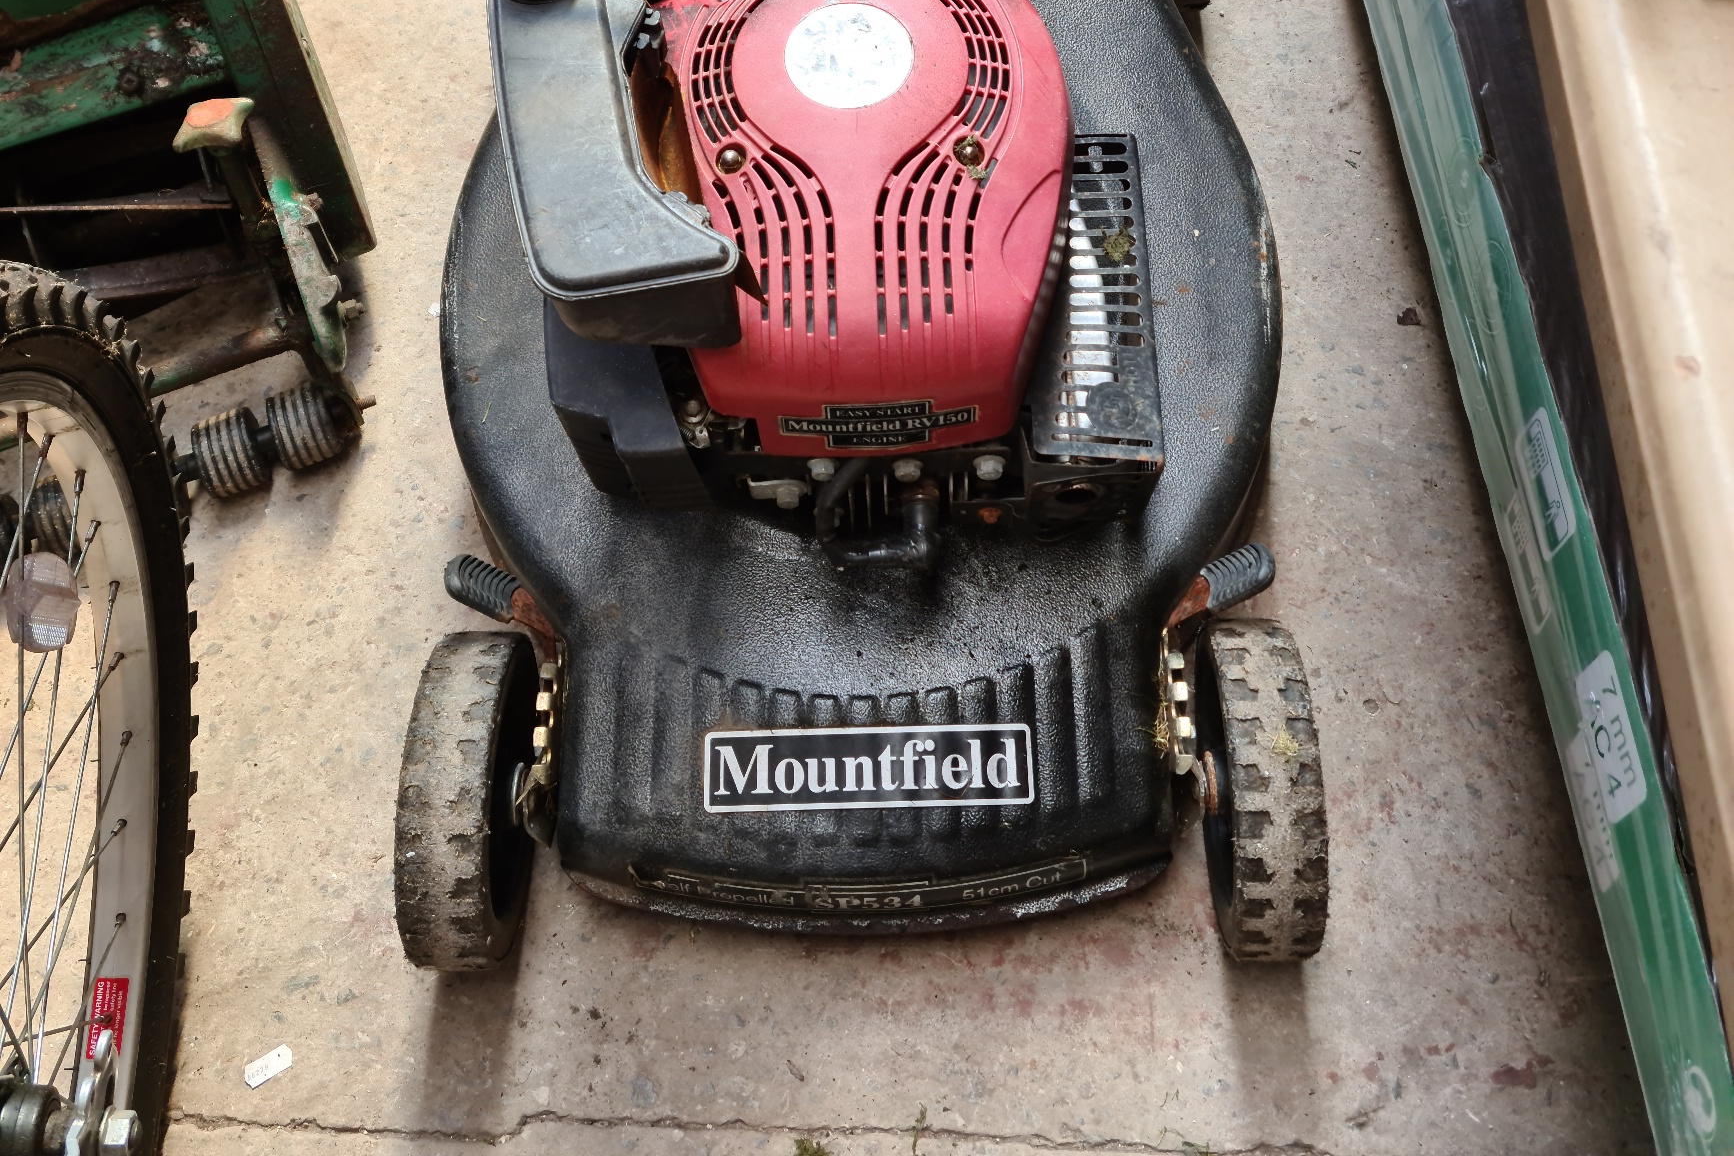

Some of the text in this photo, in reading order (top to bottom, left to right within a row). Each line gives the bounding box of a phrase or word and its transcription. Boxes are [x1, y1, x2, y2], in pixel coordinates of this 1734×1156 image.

[788, 411, 968, 433] Mountfield RV150
[836, 406, 922, 418] EASY START
[853, 435, 907, 444] ENGINE
[1602, 676, 1636, 787] 7 mm
[713, 738, 1022, 796] Mountfield
[1608, 774, 1622, 798] 4
[813, 894, 923, 910] SP534
[962, 883, 1019, 900] 51cm
[1025, 871, 1062, 889] Cut
[89, 1023, 99, 1056] SAFETY
